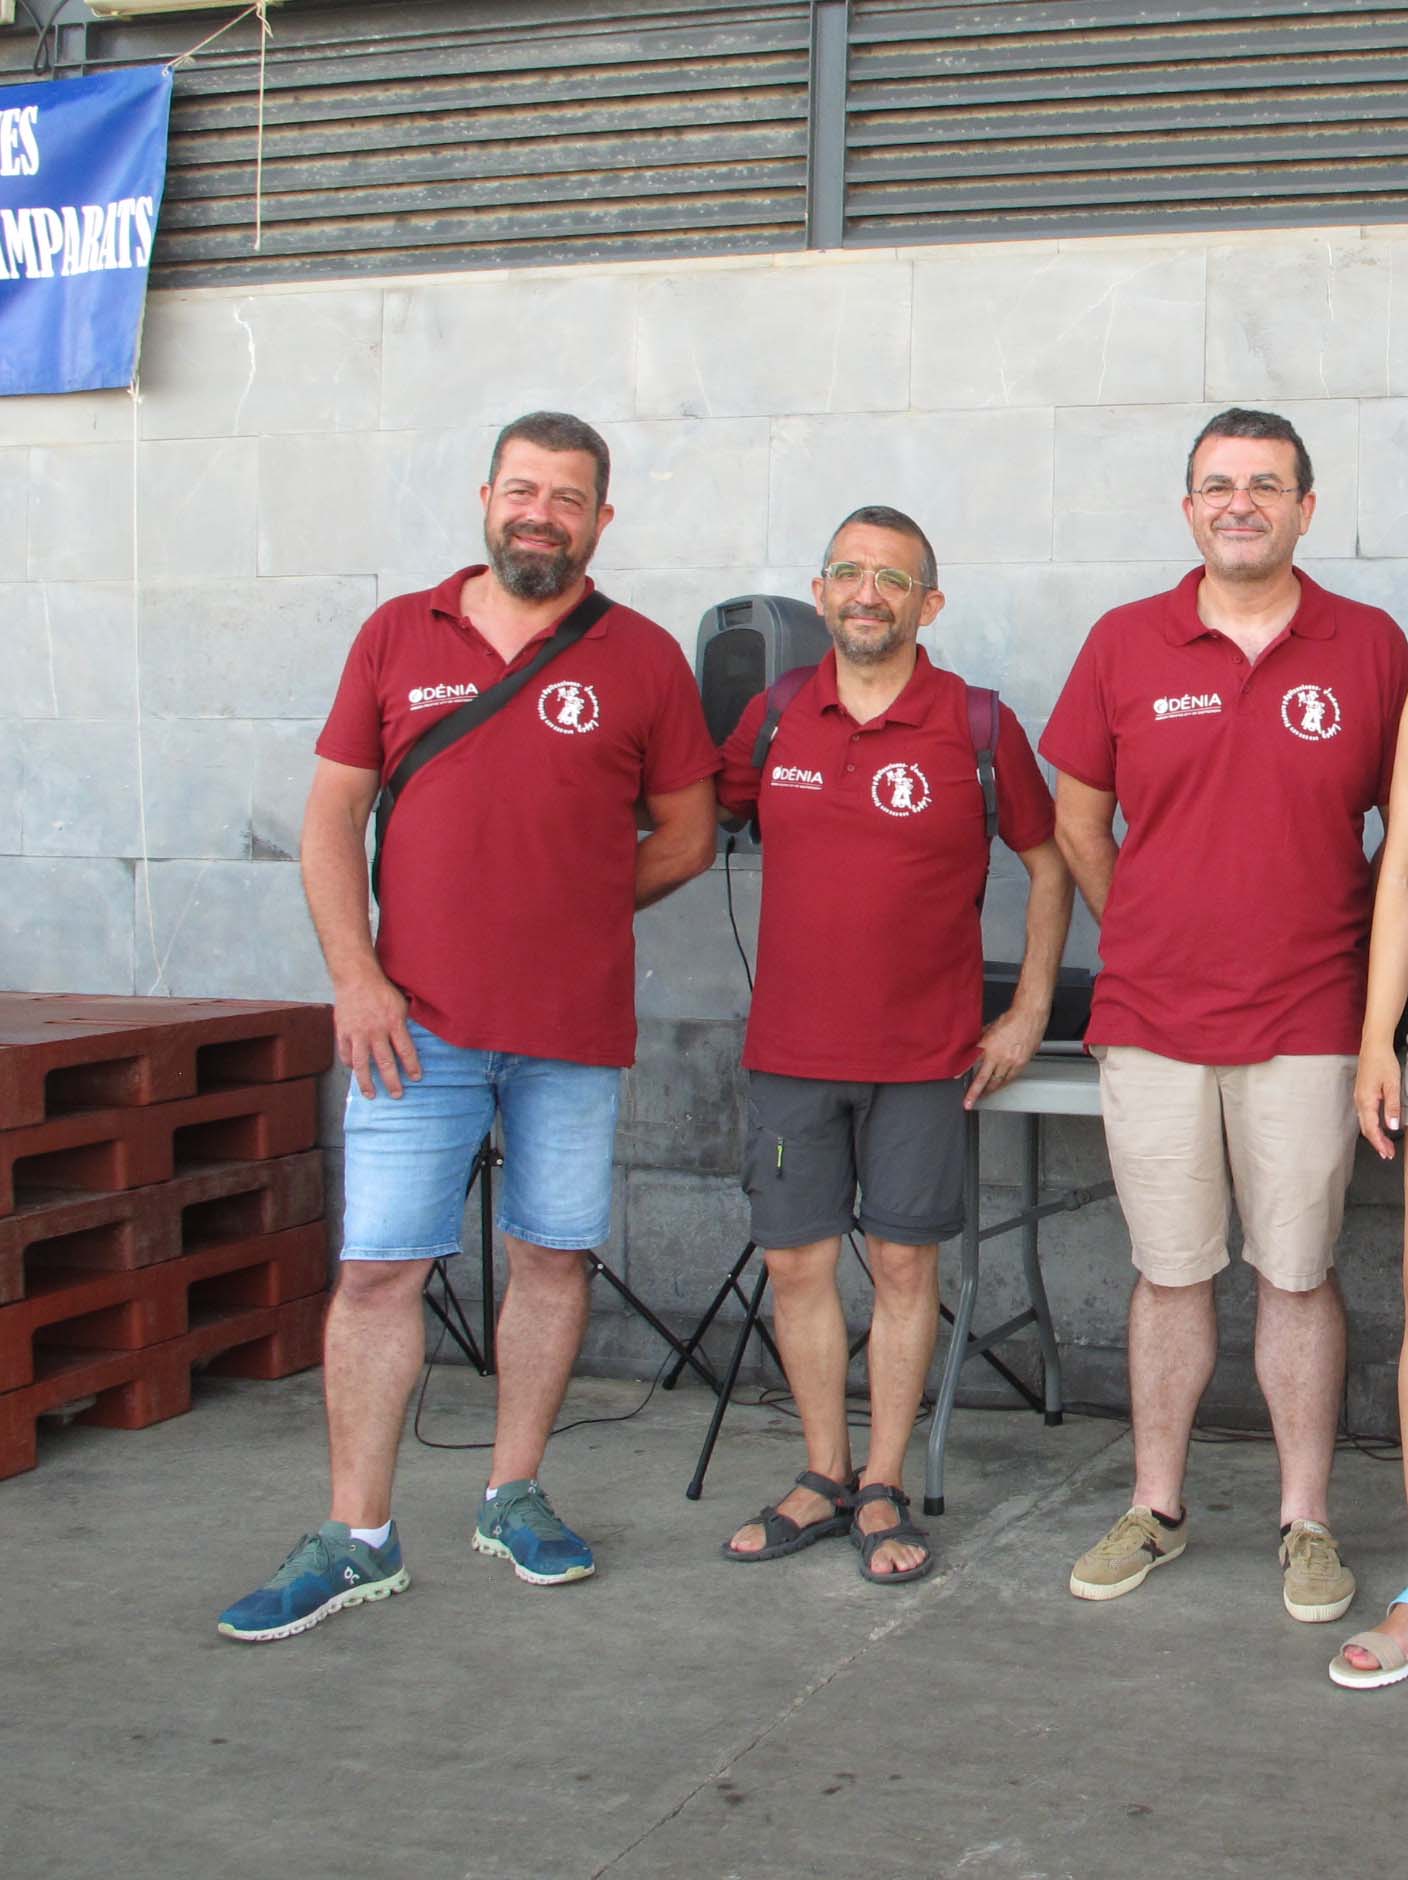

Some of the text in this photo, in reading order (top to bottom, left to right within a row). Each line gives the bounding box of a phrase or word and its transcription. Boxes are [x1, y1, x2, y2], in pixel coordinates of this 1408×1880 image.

[0, 105, 39, 176] ES
[0, 196, 153, 279] MPARATS
[423, 682, 479, 701] DÉNIA
[1168, 693, 1222, 712] DÉNIA
[780, 765, 824, 784] DÉNIA
